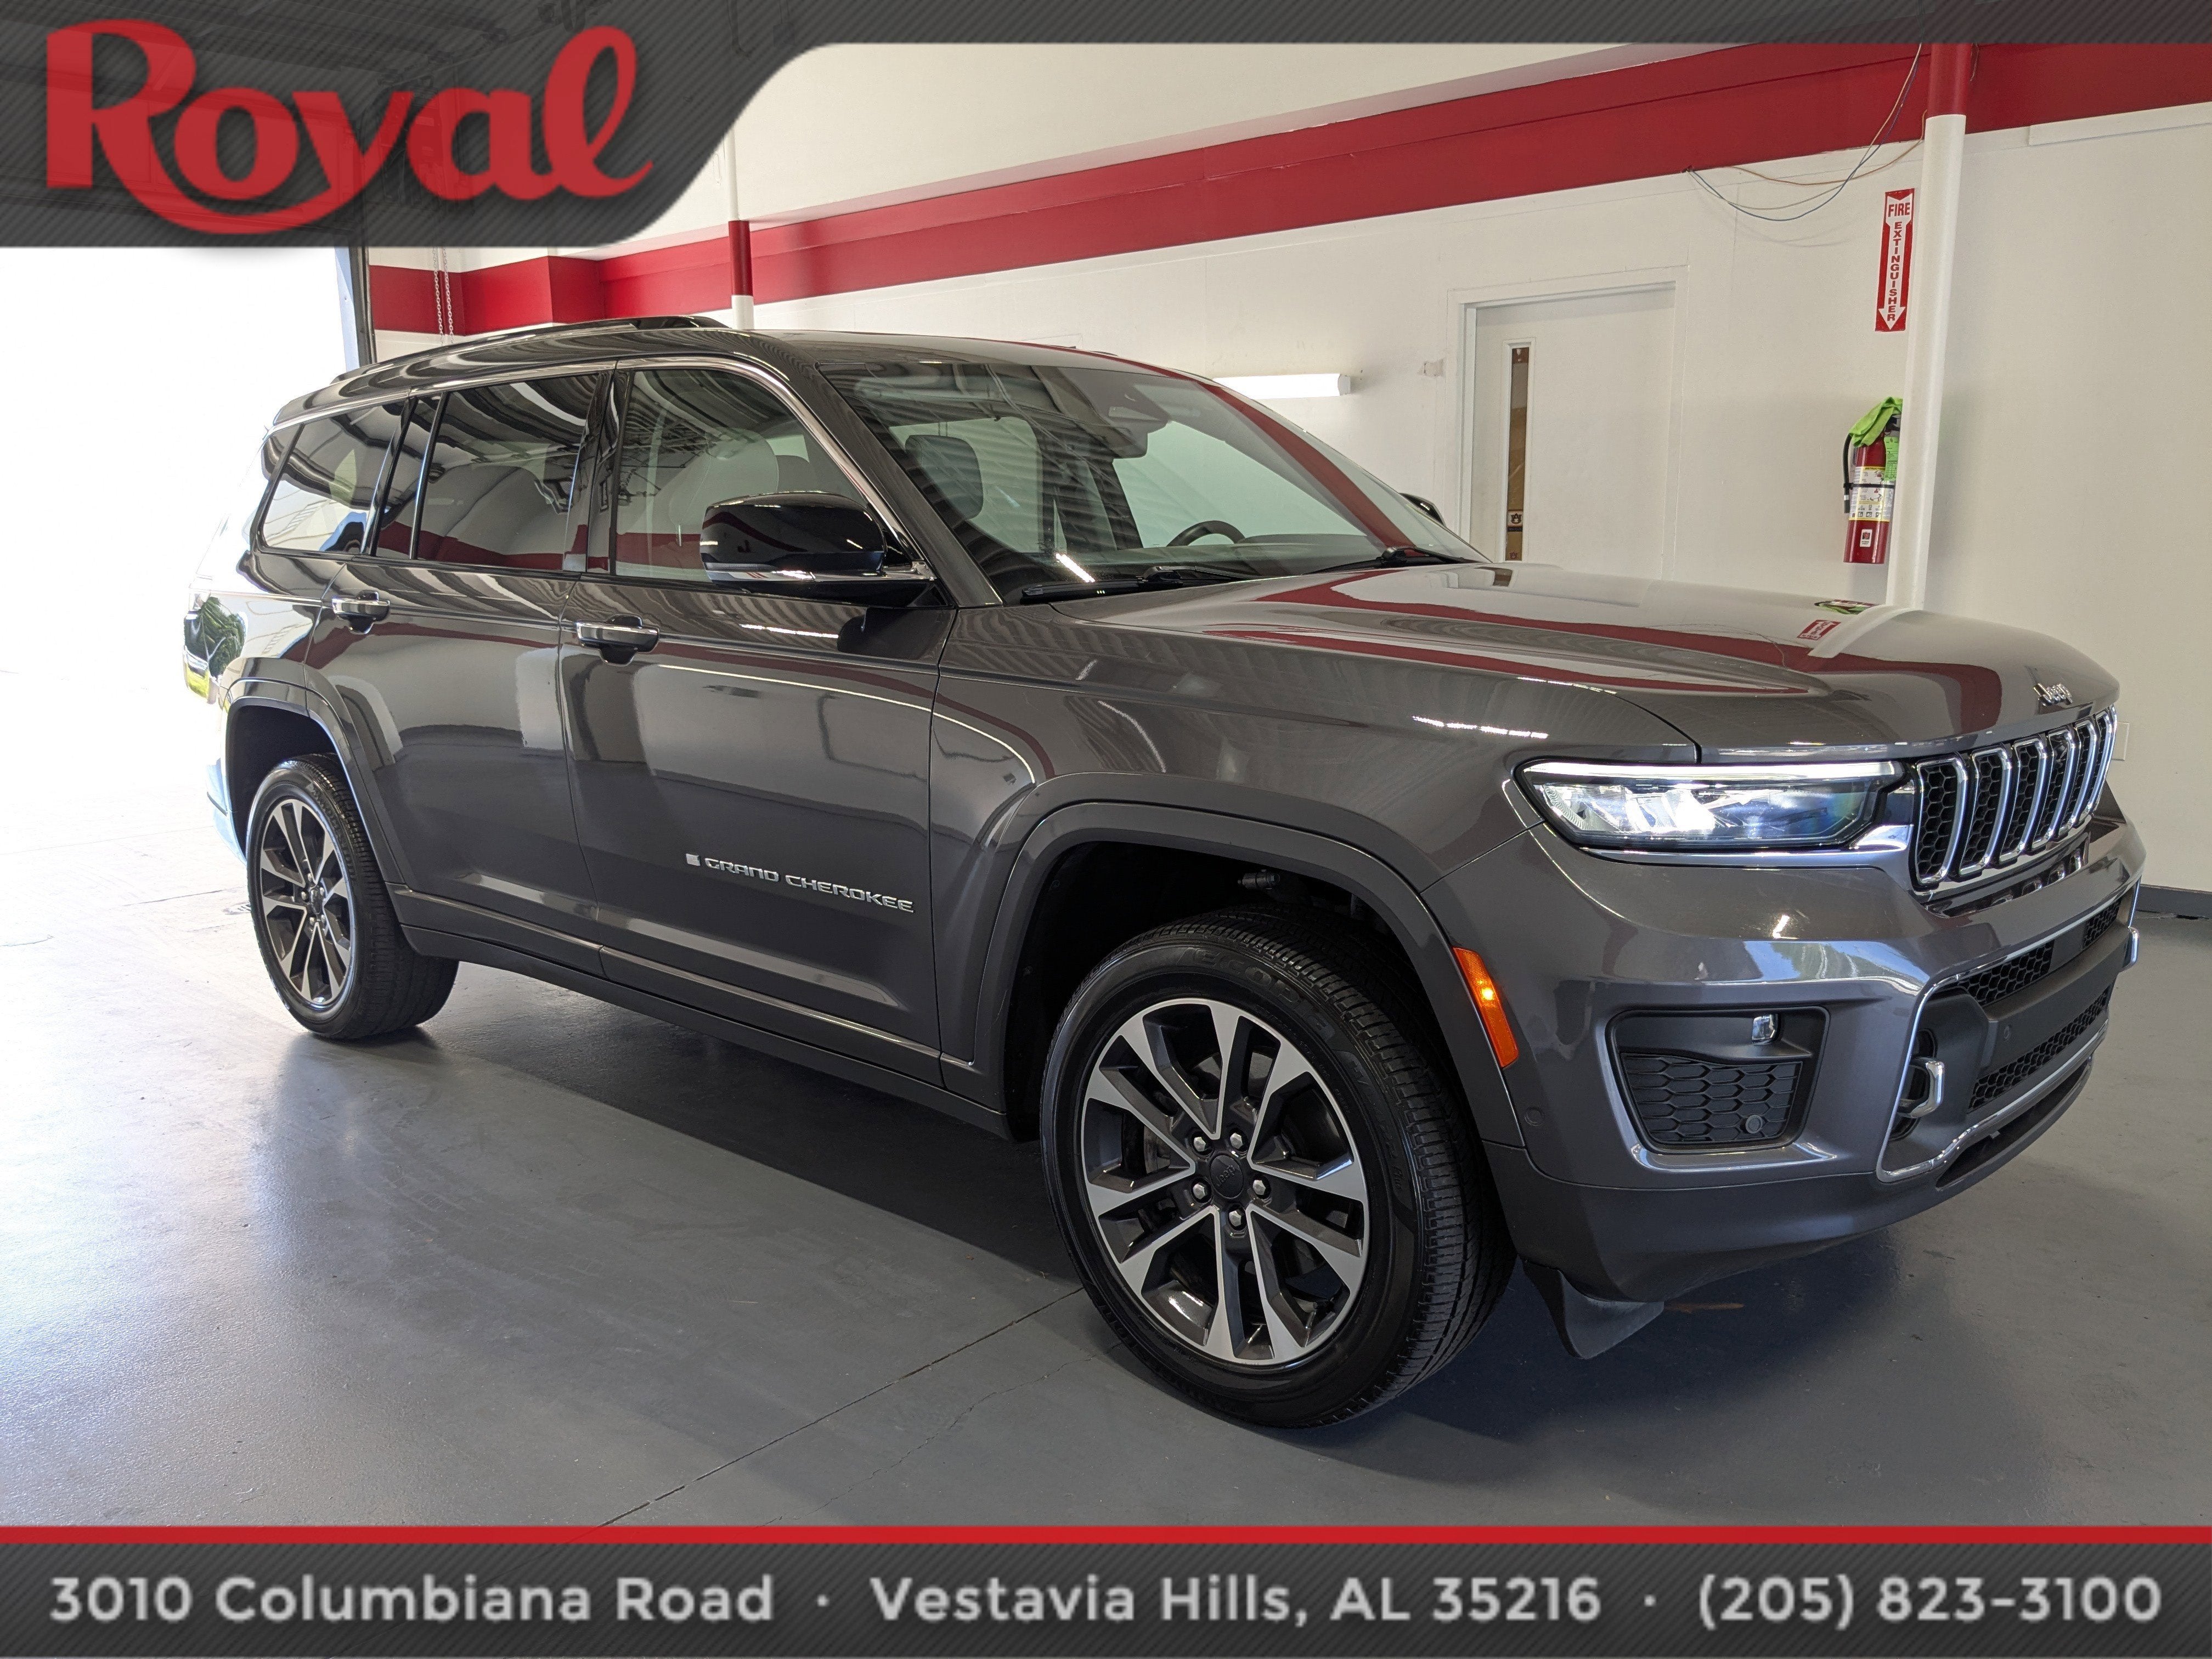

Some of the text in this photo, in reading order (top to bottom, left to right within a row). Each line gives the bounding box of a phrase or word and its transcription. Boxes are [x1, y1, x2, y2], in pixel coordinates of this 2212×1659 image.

[1888, 202, 1911, 217] FIRE
[1887, 221, 1903, 321] EXTINGUISHER
[704, 857, 915, 913] GRAND CHEROKEE
